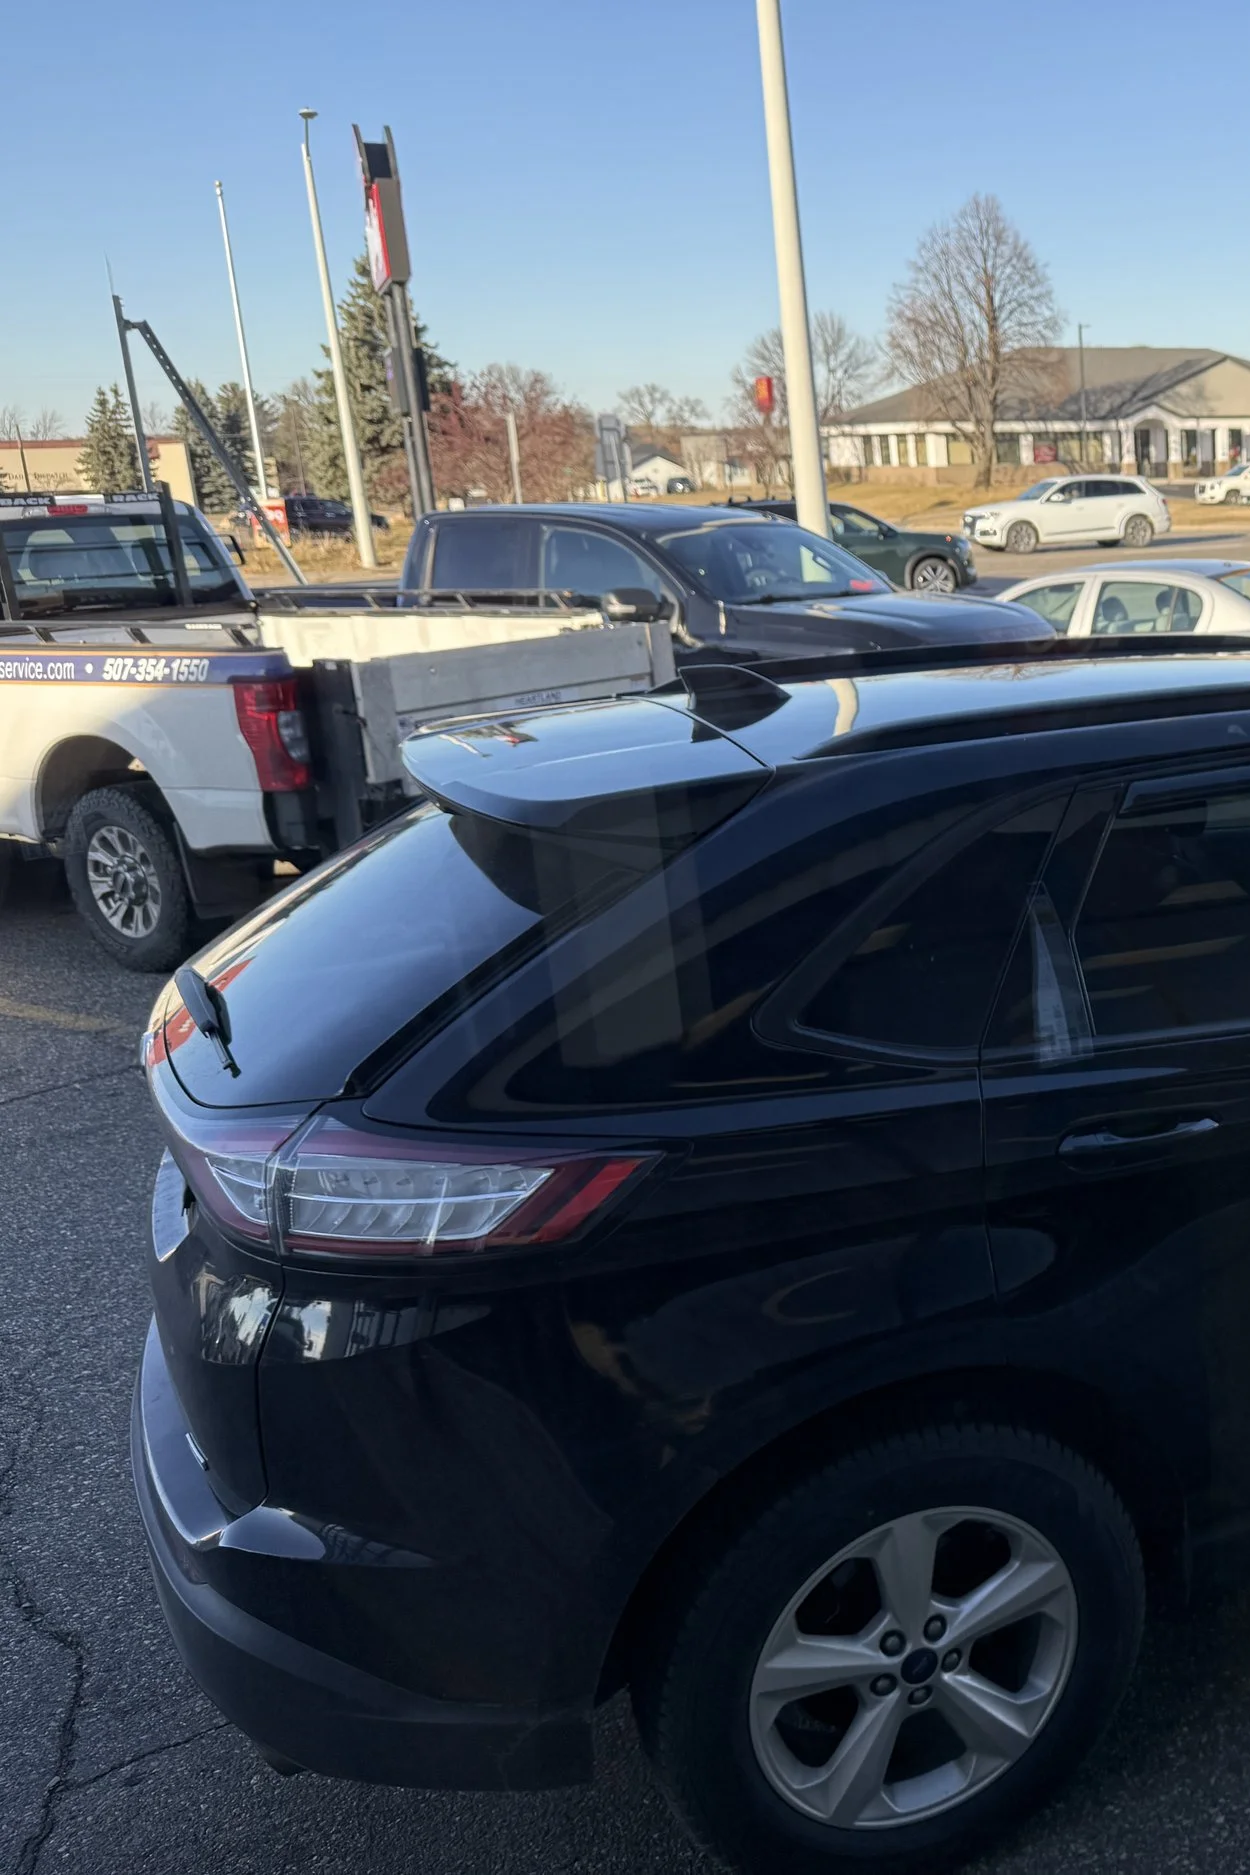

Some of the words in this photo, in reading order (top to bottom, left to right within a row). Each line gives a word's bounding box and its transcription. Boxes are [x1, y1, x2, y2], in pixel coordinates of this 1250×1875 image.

[112, 493, 159, 502] RACK
[0, 656, 75, 679] service.com
[103, 657, 209, 682] 507-354-1550
